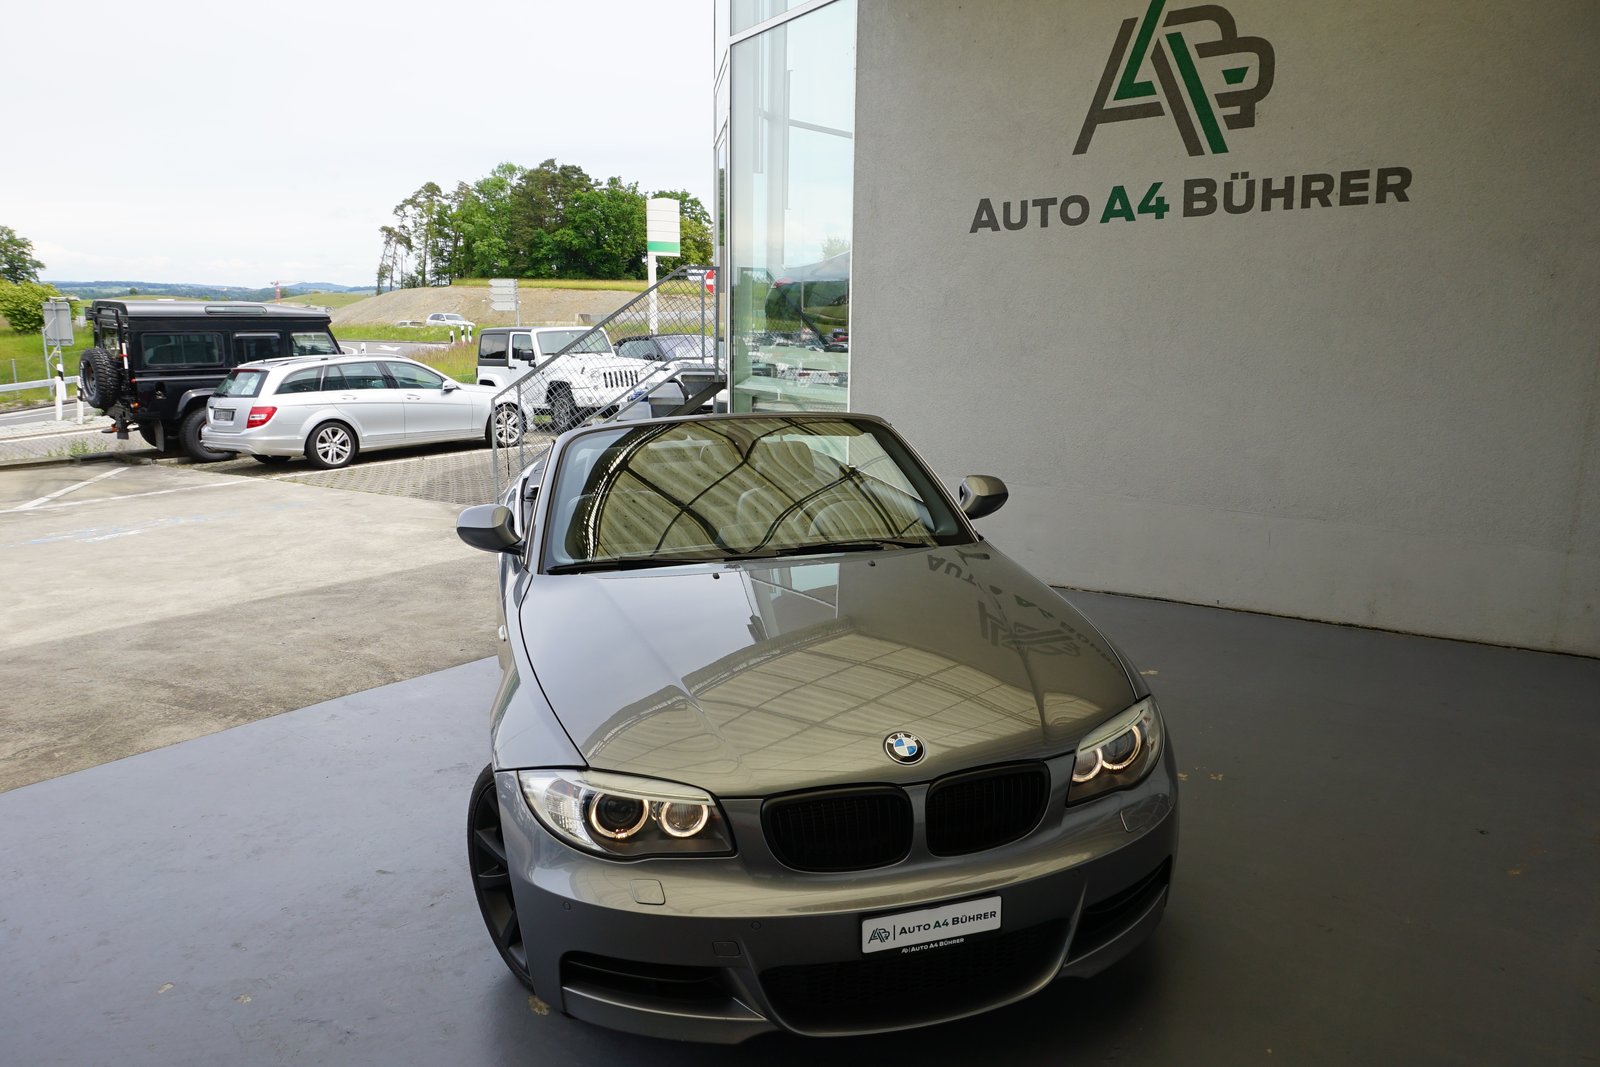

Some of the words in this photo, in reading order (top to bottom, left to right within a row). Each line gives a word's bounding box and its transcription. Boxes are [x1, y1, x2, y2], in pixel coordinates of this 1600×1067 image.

[969, 194, 1091, 234] AUTO
[1099, 181, 1171, 224] A4
[1182, 166, 1414, 218] BÜHRER
[899, 923, 931, 936] AUTO
[933, 919, 949, 929] A4
[952, 911, 997, 925] BÜHRER
[911, 945, 928, 953] AUTO
[940, 938, 964, 947] BÜHRER
